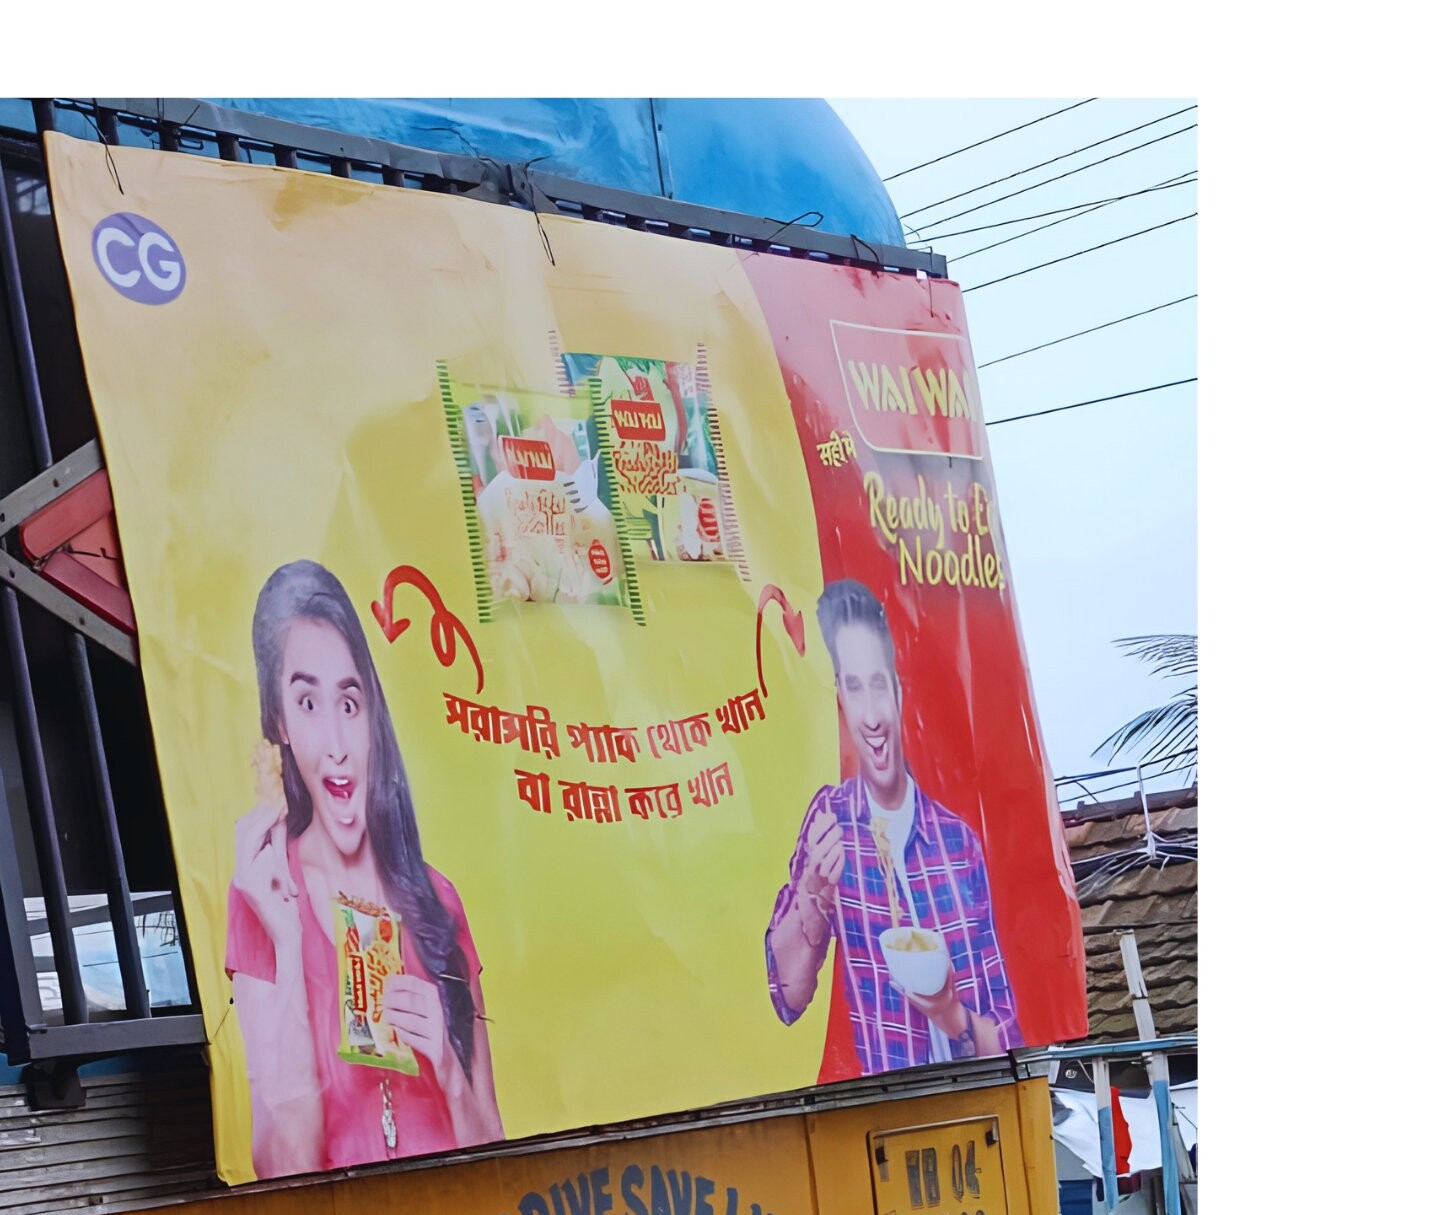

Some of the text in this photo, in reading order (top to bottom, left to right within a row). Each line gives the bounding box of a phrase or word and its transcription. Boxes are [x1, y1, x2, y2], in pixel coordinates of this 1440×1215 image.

[94, 225, 182, 291] CG
[847, 359, 978, 423] WAI WAI
[863, 471, 946, 550] Ready
[944, 481, 970, 533] to
[442, 688, 767, 764] সরাসরি প্যাক থেকে খান
[514, 761, 735, 824] বা রান্না করে খান
